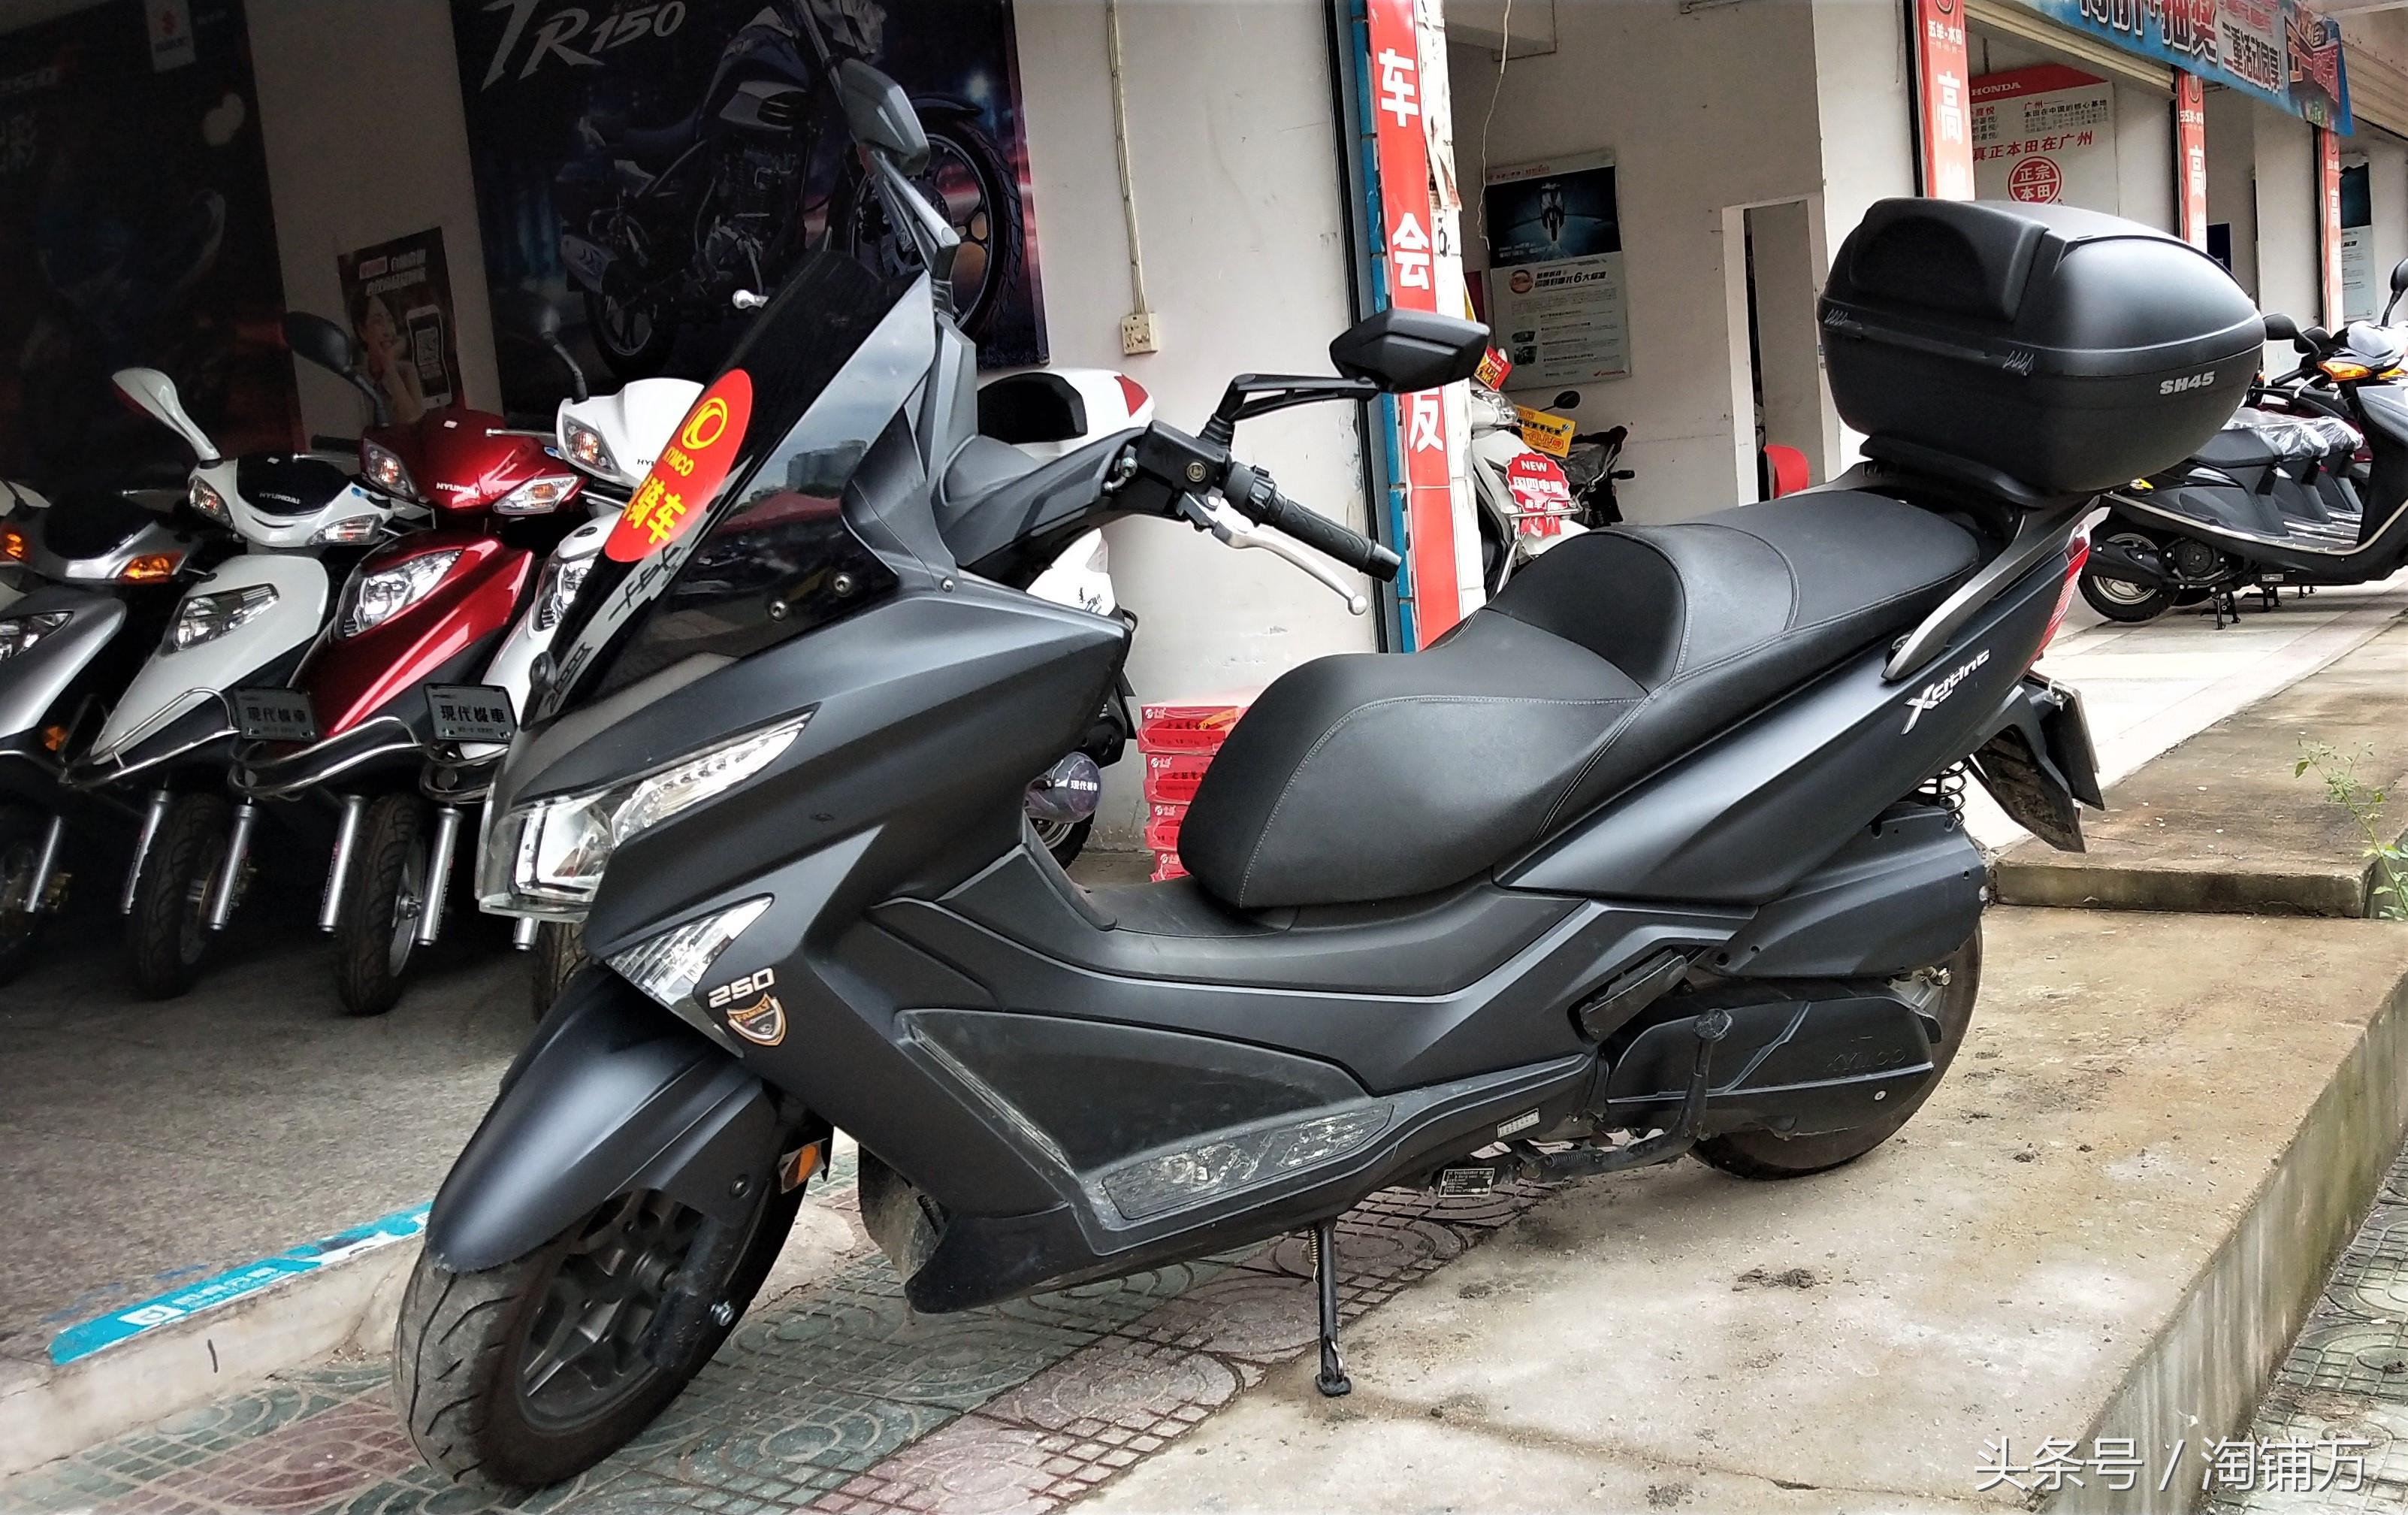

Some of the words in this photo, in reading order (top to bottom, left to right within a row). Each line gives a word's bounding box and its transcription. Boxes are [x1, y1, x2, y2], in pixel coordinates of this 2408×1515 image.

[1971, 82, 2021, 96] HONDA
[1974, 131, 2092, 162] 真正本田在广州
[2020, 164, 2050, 182] 正宗
[2020, 185, 2050, 201] 本田
[2159, 370, 2216, 395] SH45
[1521, 460, 1547, 472] NEW
[708, 968, 775, 1008] 250
